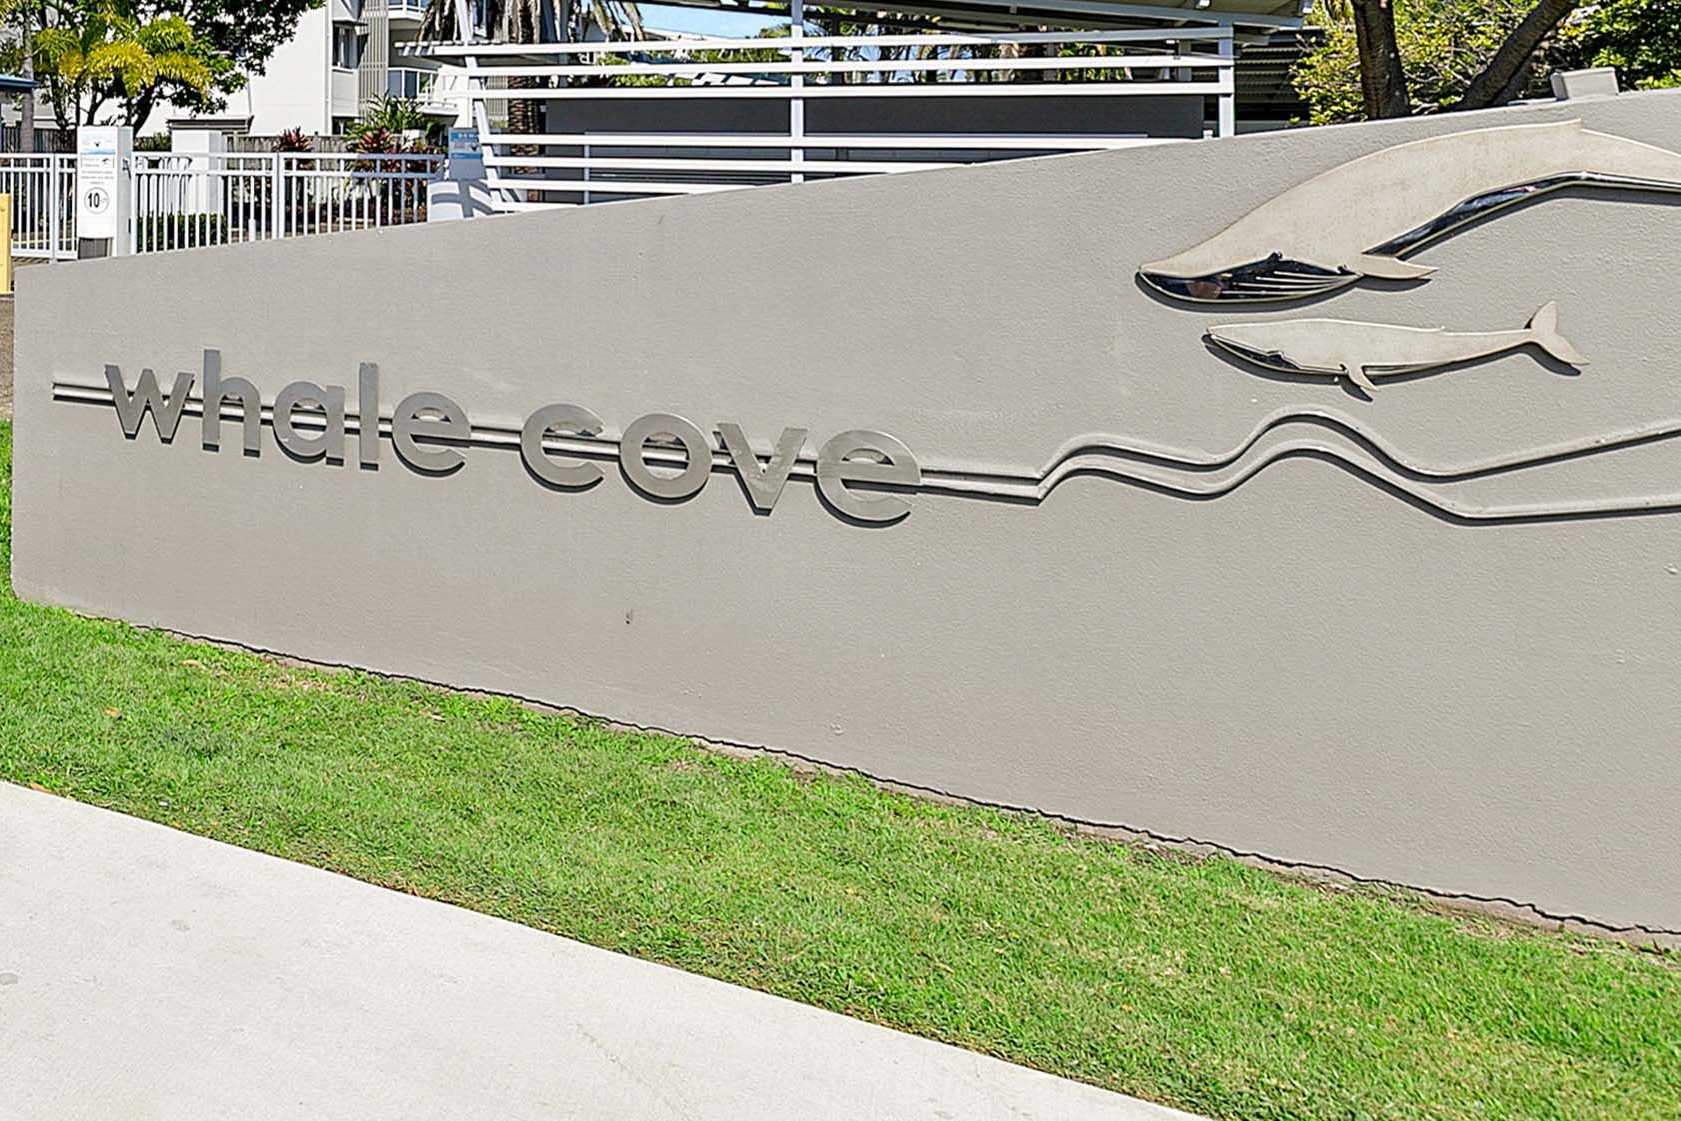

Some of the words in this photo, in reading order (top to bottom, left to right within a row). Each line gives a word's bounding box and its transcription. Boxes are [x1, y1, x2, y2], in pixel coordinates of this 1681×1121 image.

[88, 192, 100, 208] 10
[104, 348, 472, 477] whale
[520, 403, 921, 529] cove
